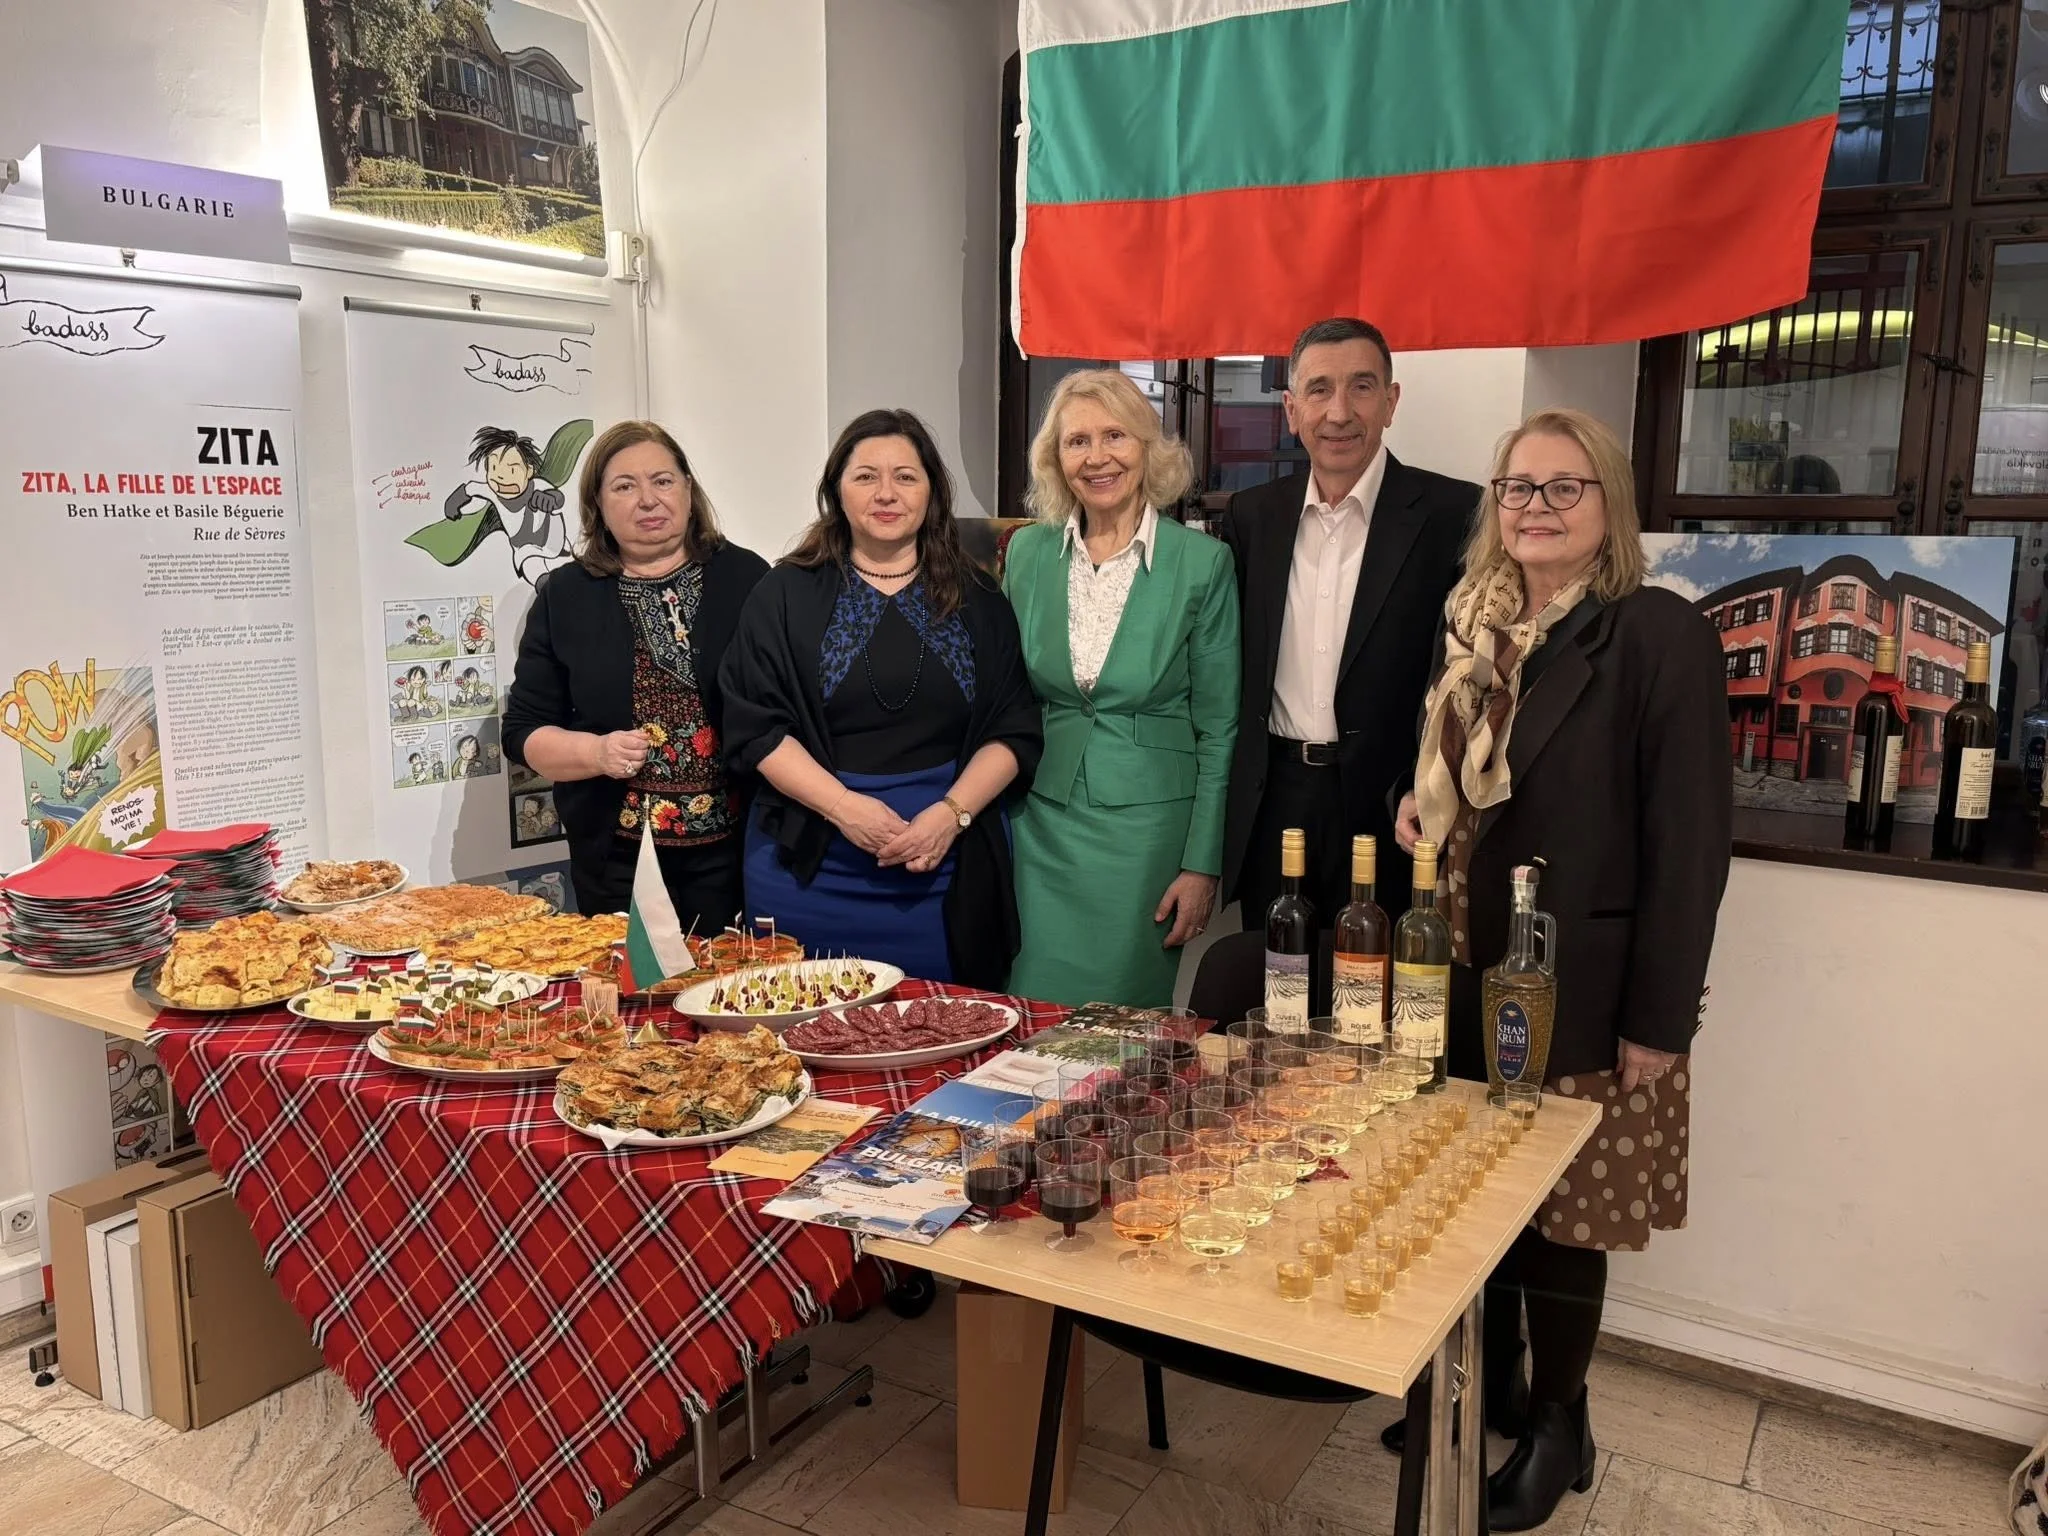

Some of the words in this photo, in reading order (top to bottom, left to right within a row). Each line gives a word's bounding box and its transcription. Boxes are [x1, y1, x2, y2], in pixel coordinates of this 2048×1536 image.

[103, 186, 235, 218] BULGARIE
[22, 310, 109, 342] badass
[492, 359, 546, 382] badass
[197, 426, 279, 466] ZITA
[22, 472, 76, 495] ZITA,
[84, 473, 110, 494] LA
[117, 474, 165, 494] FILLE
[173, 475, 195, 495] DE
[203, 476, 282, 495] L'ESPACE
[67, 504, 98, 518] Ben
[103, 504, 151, 518] Hatke
[156, 506, 169, 518] et
[174, 504, 219, 518] Basile
[223, 504, 284, 521] Béguerie
[193, 527, 220, 541] Rue
[225, 527, 240, 541] de
[244, 526, 285, 541] Sèvres
[0, 658, 96, 766] POW
[110, 797, 144, 815] RENDS-
[110, 813, 128, 826] MOI
[129, 808, 143, 819] MA
[121, 820, 136, 831] VIE
[1497, 1023, 1526, 1035] KHAN
[1497, 1032, 1526, 1044] KRUM
